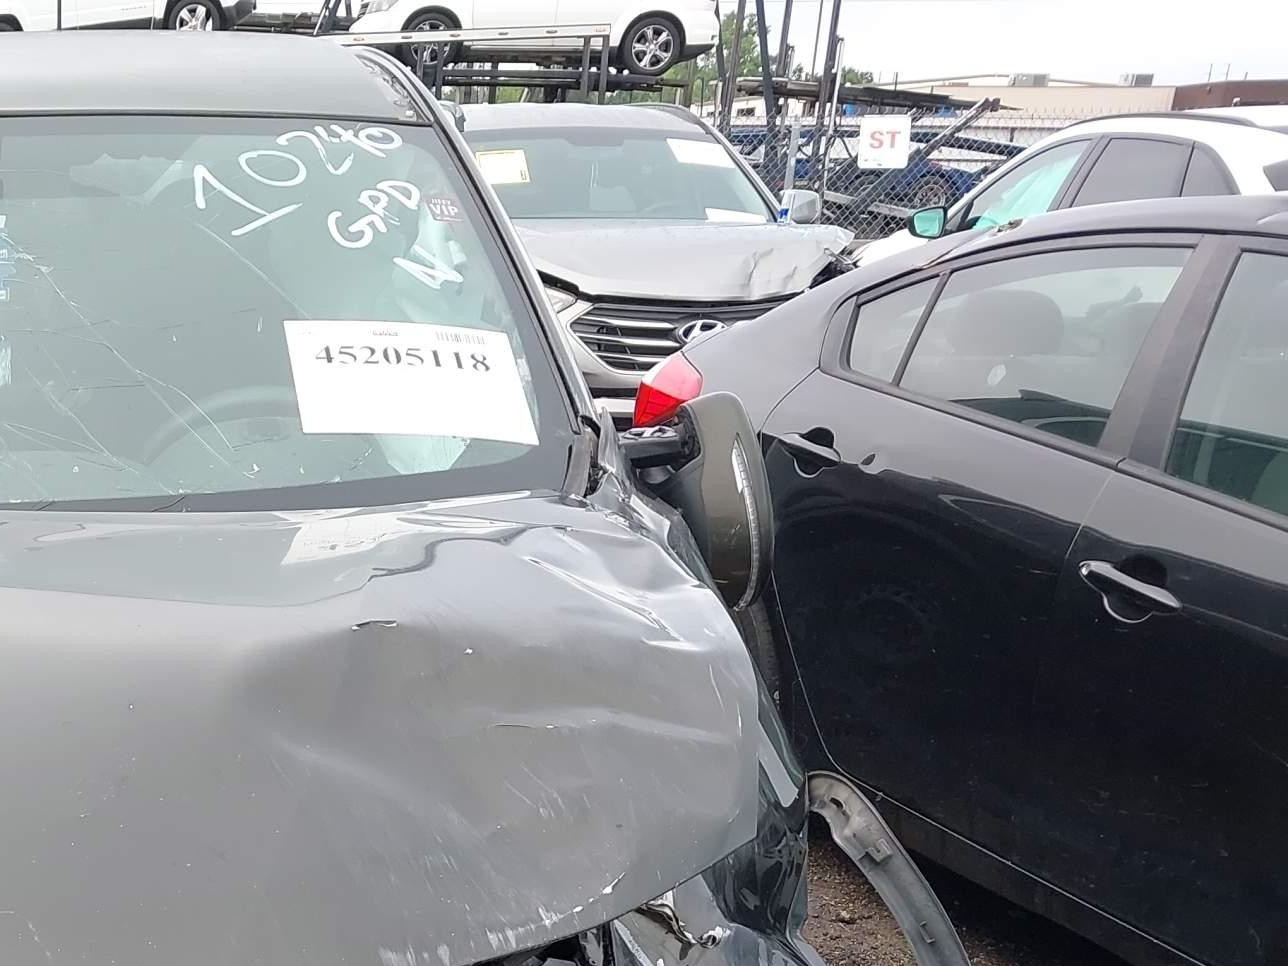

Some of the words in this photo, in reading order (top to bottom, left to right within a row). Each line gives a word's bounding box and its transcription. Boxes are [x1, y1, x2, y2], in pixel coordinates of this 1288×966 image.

[869, 130, 901, 149] ST
[428, 203, 459, 216] VIP
[315, 345, 491, 372] 45205118
